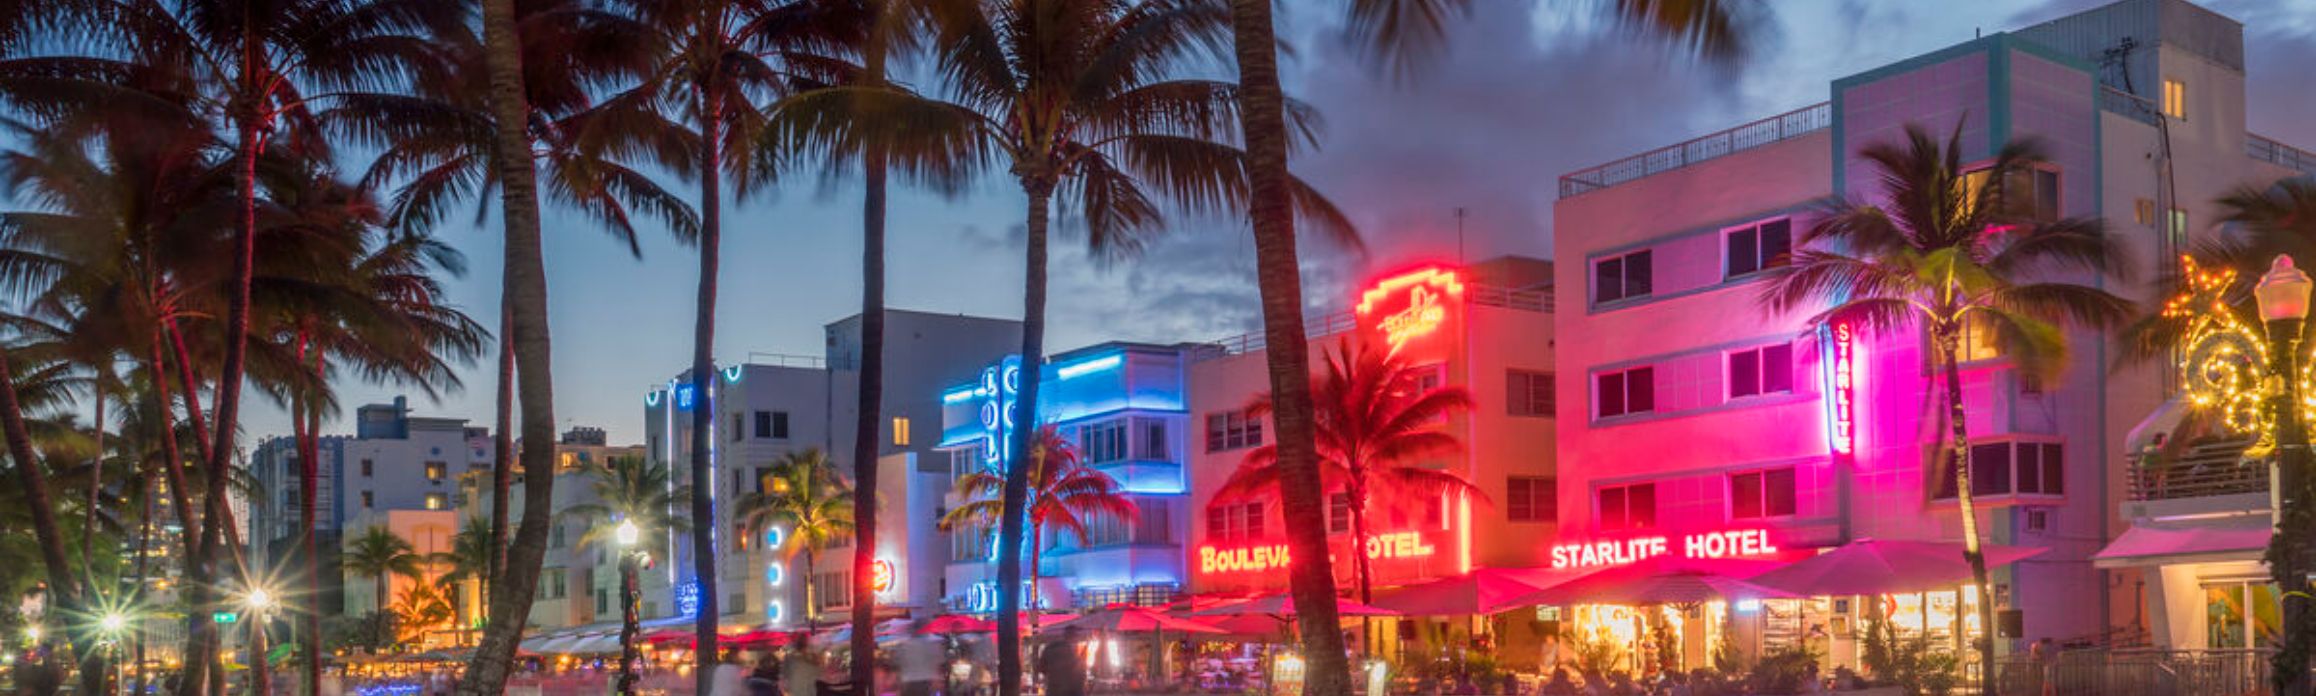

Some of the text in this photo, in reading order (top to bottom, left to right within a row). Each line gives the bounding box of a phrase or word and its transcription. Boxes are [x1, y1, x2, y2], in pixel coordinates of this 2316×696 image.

[1837, 323, 1851, 454] STARLITE
[1200, 531, 1435, 573] BOULEVA OTEL
[1551, 529, 1776, 568] STARLITE HOTEL
